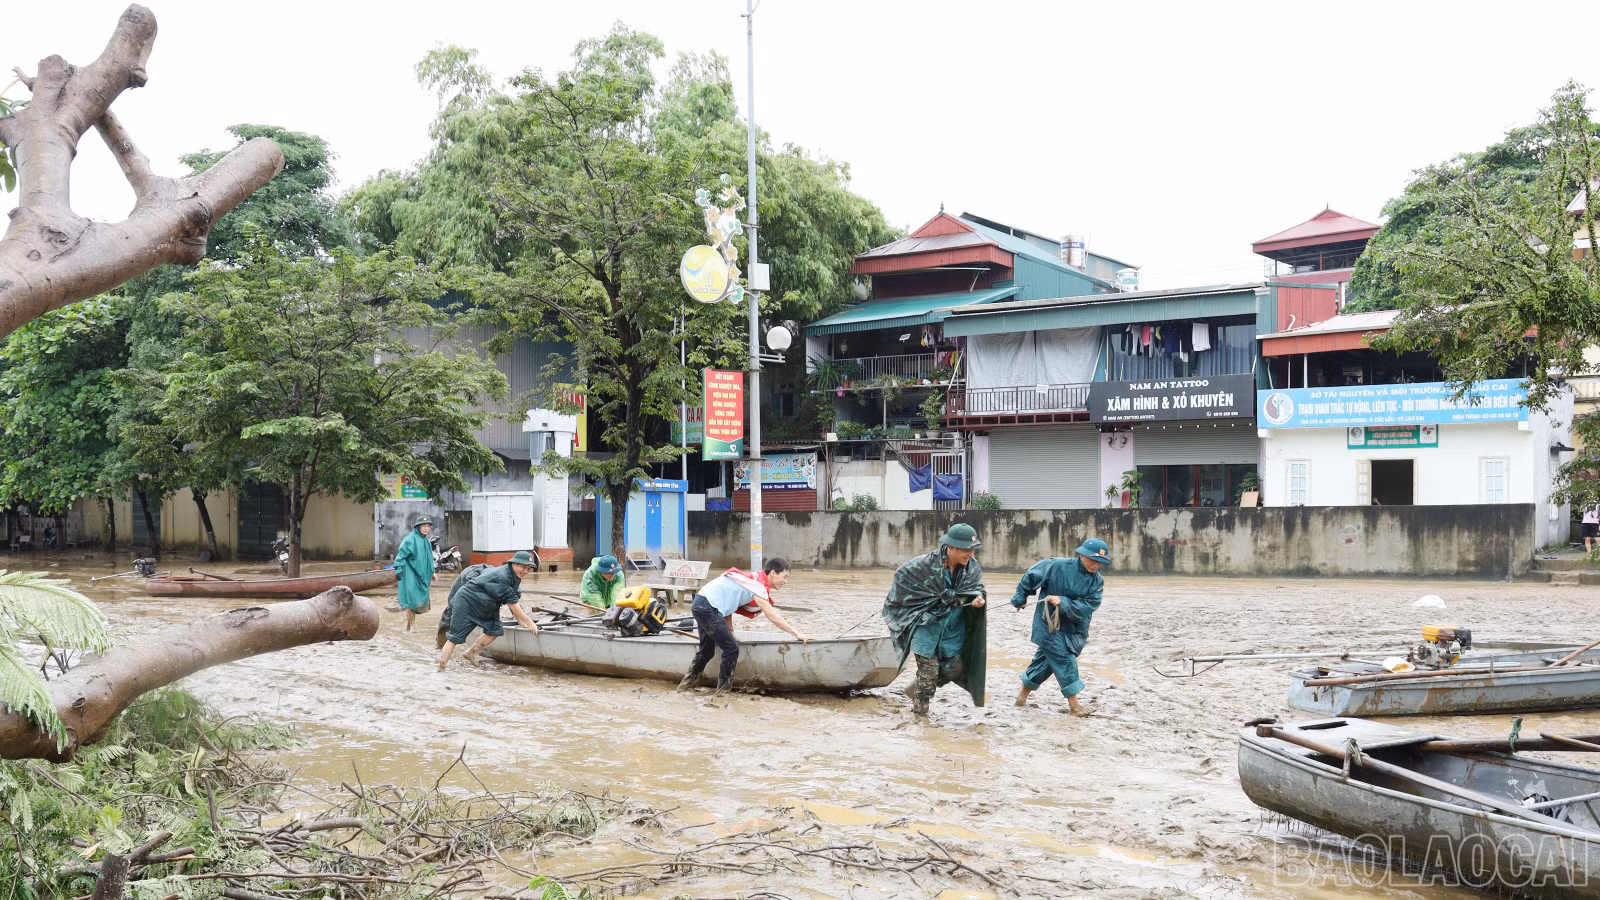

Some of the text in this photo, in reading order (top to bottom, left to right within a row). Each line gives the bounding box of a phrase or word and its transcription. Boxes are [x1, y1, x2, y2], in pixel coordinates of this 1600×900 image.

[1129, 379, 1209, 391] NAM AN TATTOO
[1339, 388, 1374, 397] NGUYÊN
[1376, 387, 1388, 396] VÀ
[1492, 383, 1508, 391] CAI
[1107, 390, 1234, 412] XĂM HÌNH & XỎ KHUYÊN
[1298, 401, 1314, 417] TRẠM
[1314, 401, 1330, 416] QUAN
[710, 449, 740, 457] Vietcombank
